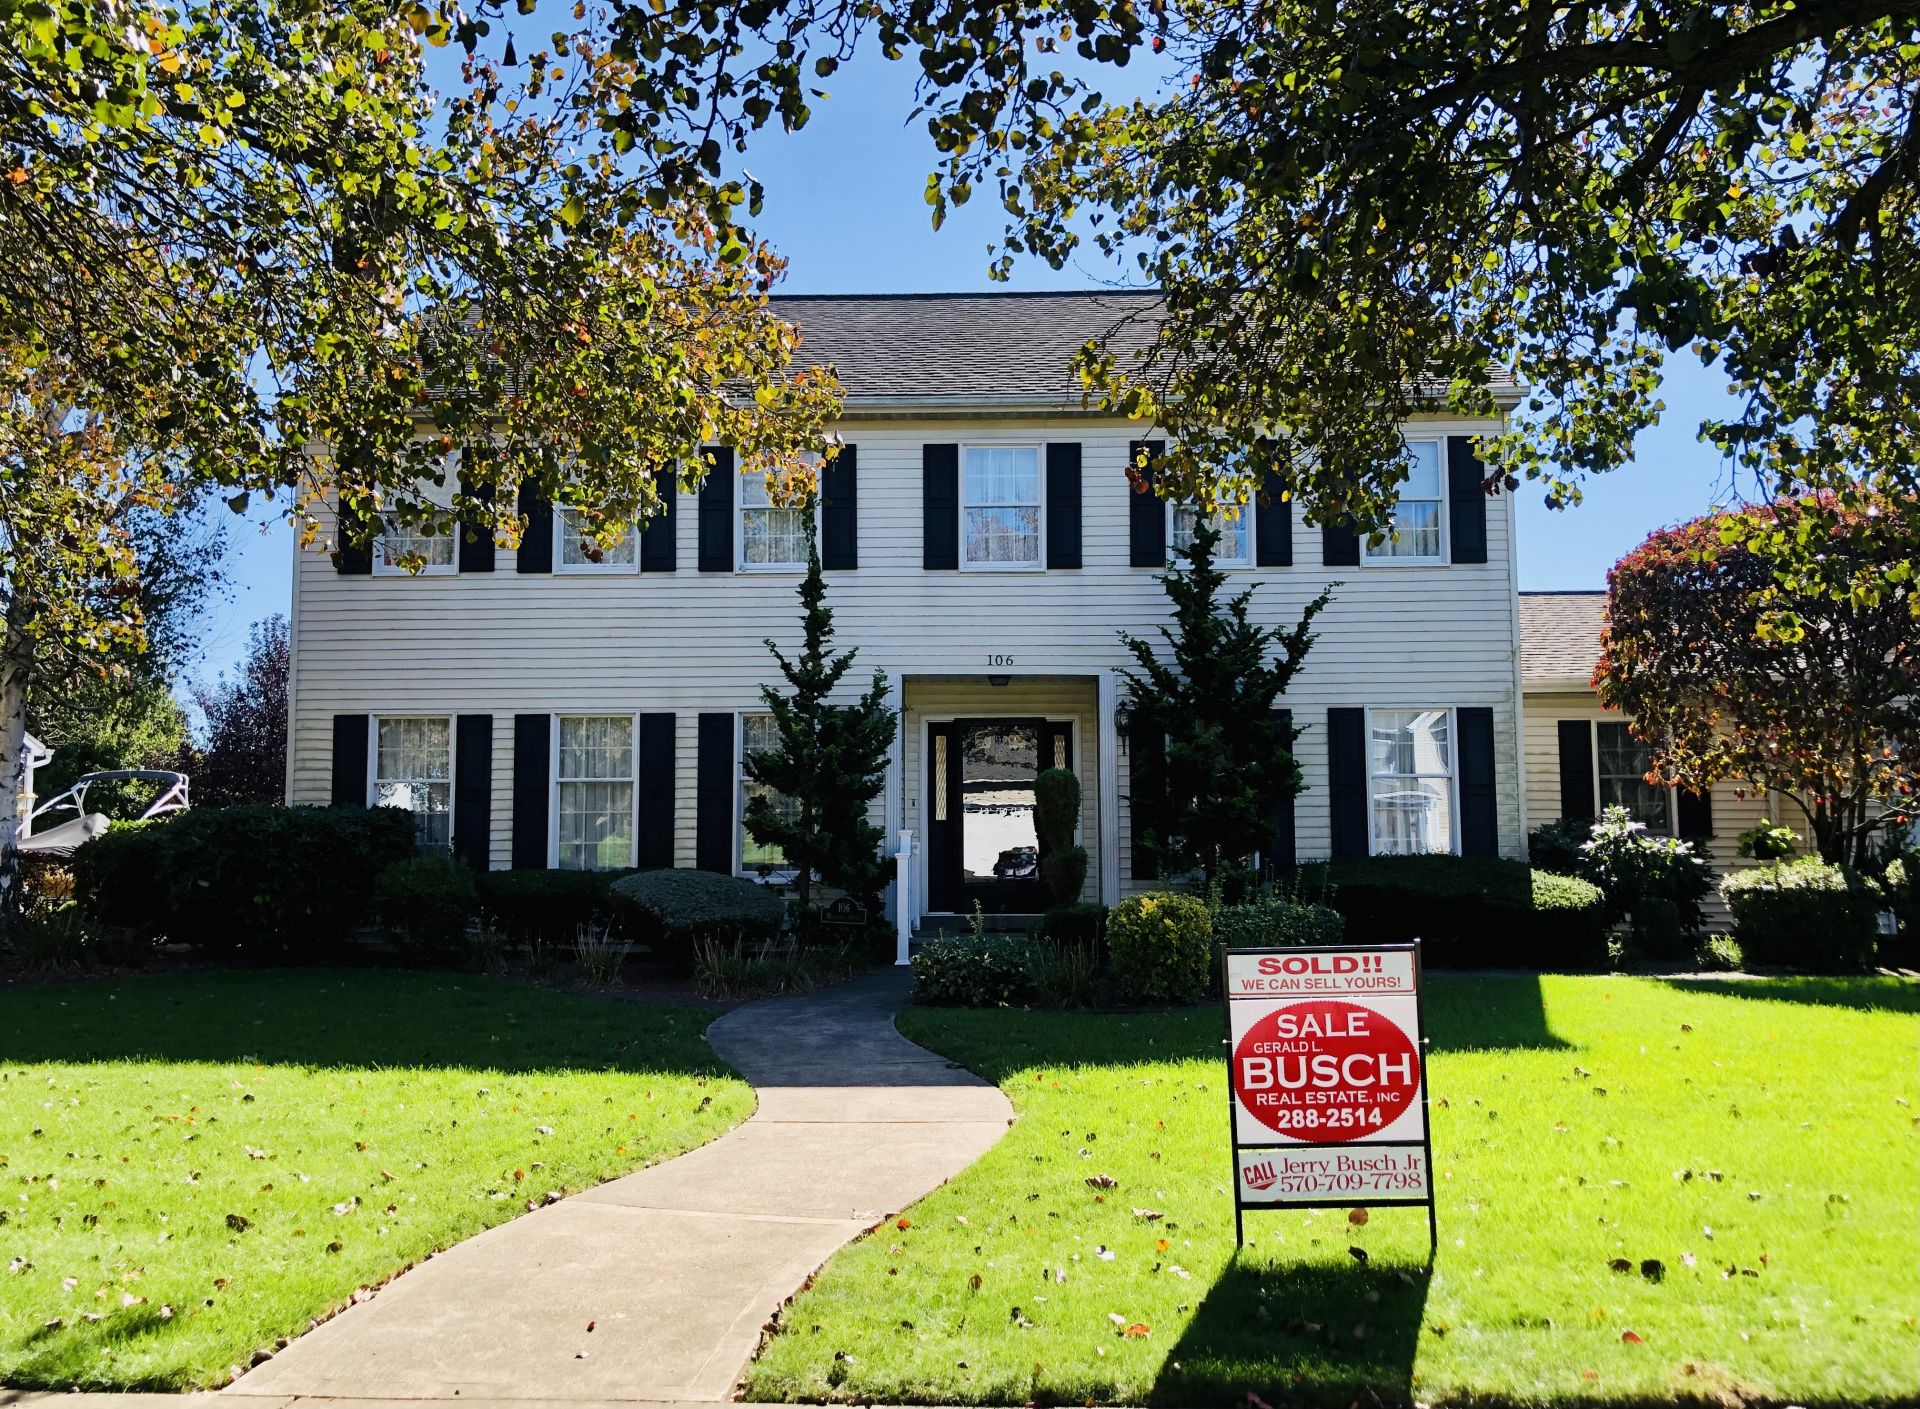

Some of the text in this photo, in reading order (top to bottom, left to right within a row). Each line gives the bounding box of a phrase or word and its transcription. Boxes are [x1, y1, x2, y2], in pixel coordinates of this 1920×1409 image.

[987, 654, 1014, 666] 106
[1257, 956, 1383, 975] SOLD!!
[1242, 976, 1401, 990] WE CAN SELL YOURS!
[1277, 1012, 1370, 1039] SALE
[1253, 1041, 1324, 1053] GERALD L.
[1242, 1053, 1412, 1090] BUSCH
[1256, 1090, 1400, 1106] REAL ESTATE, INC
[1277, 1107, 1383, 1129] 288-2514
[1243, 1161, 1278, 1185] CALL
[1280, 1154, 1421, 1177] Jerry Busch Jr
[1280, 1172, 1422, 1193] 570-709-7798
